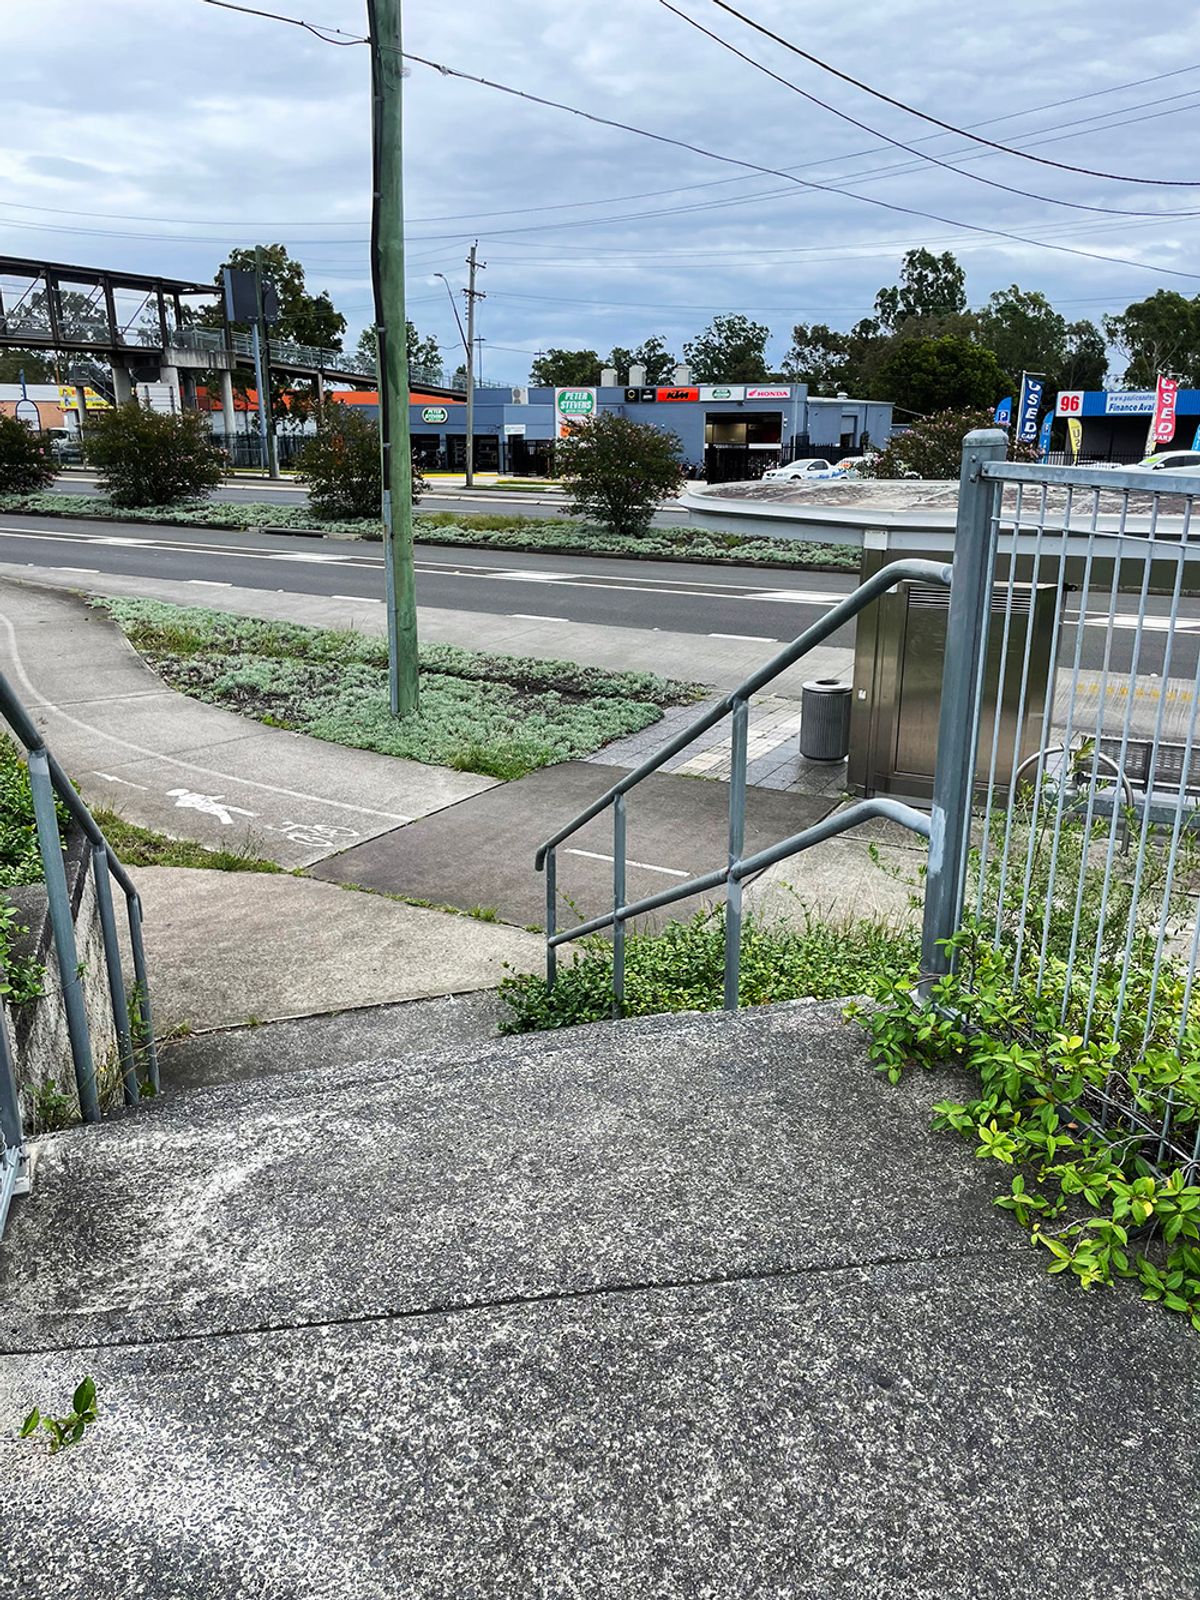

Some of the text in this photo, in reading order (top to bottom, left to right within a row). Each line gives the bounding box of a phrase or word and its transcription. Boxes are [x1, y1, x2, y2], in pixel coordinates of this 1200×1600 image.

[564, 392, 588, 400] PETER
[666, 390, 689, 399] KTM
[560, 400, 592, 409] STEVENS
[1024, 380, 1041, 433] USED
[1060, 395, 1080, 411] 96
[1108, 403, 1138, 411] Finance
[1158, 379, 1174, 433] USED
